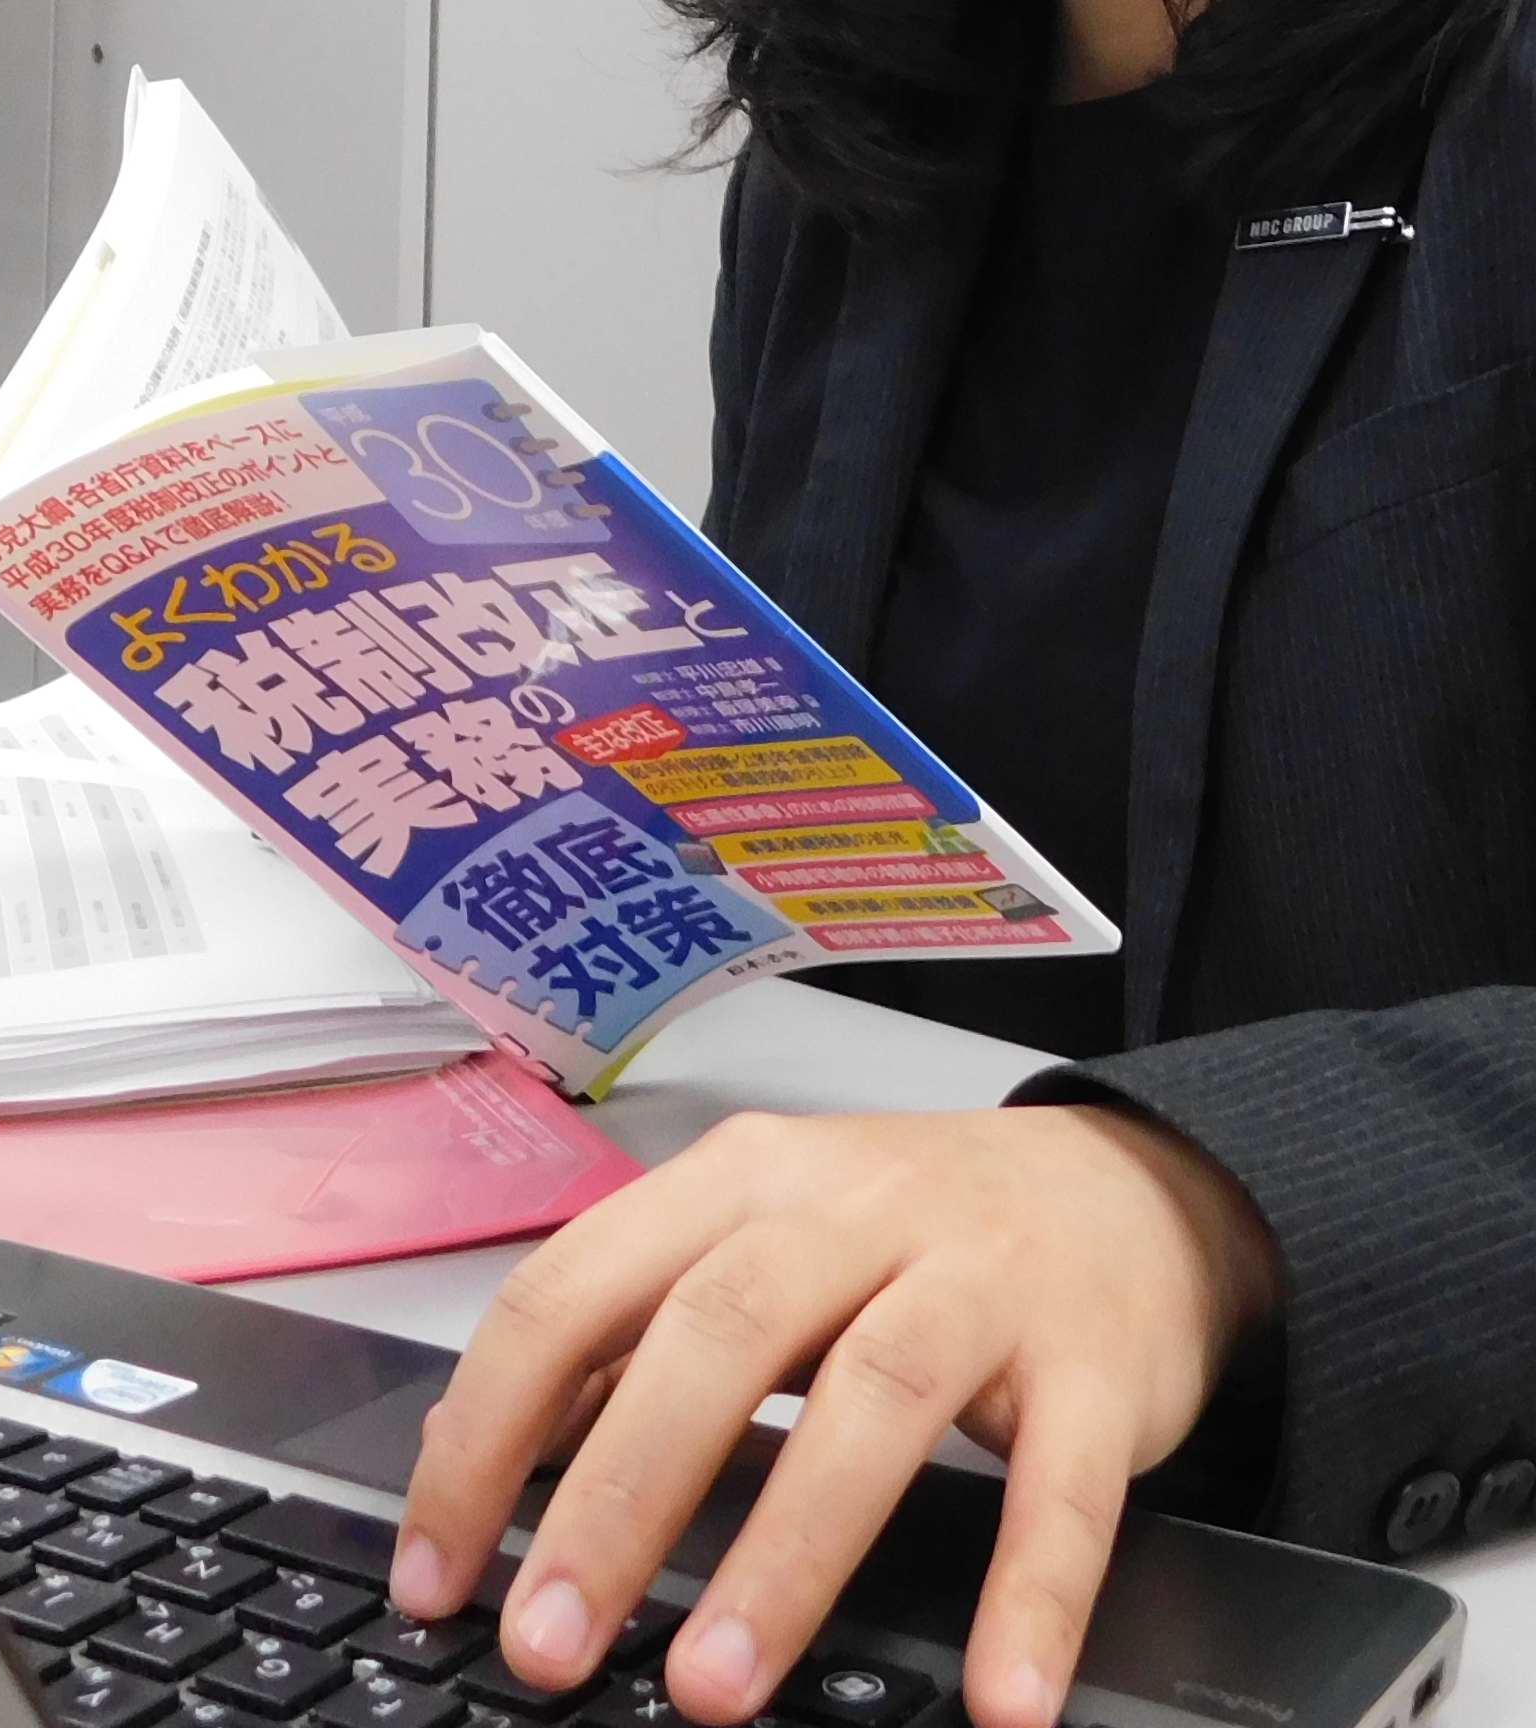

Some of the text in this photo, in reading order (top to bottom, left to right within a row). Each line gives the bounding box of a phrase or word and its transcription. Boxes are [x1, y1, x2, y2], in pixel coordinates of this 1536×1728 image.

[1283, 213, 1334, 234] GROUP
[350, 414, 543, 520] 30
[110, 522, 397, 671] よくわかる
[571, 710, 681, 761] 主な改正
[441, 816, 675, 952] 徹底
[527, 884, 753, 1017] 対策
[182, 1560, 222, 1579] N
[296, 1592, 324, 1610] B
[144, 1622, 184, 1645] H
[255, 1658, 291, 1680] G
